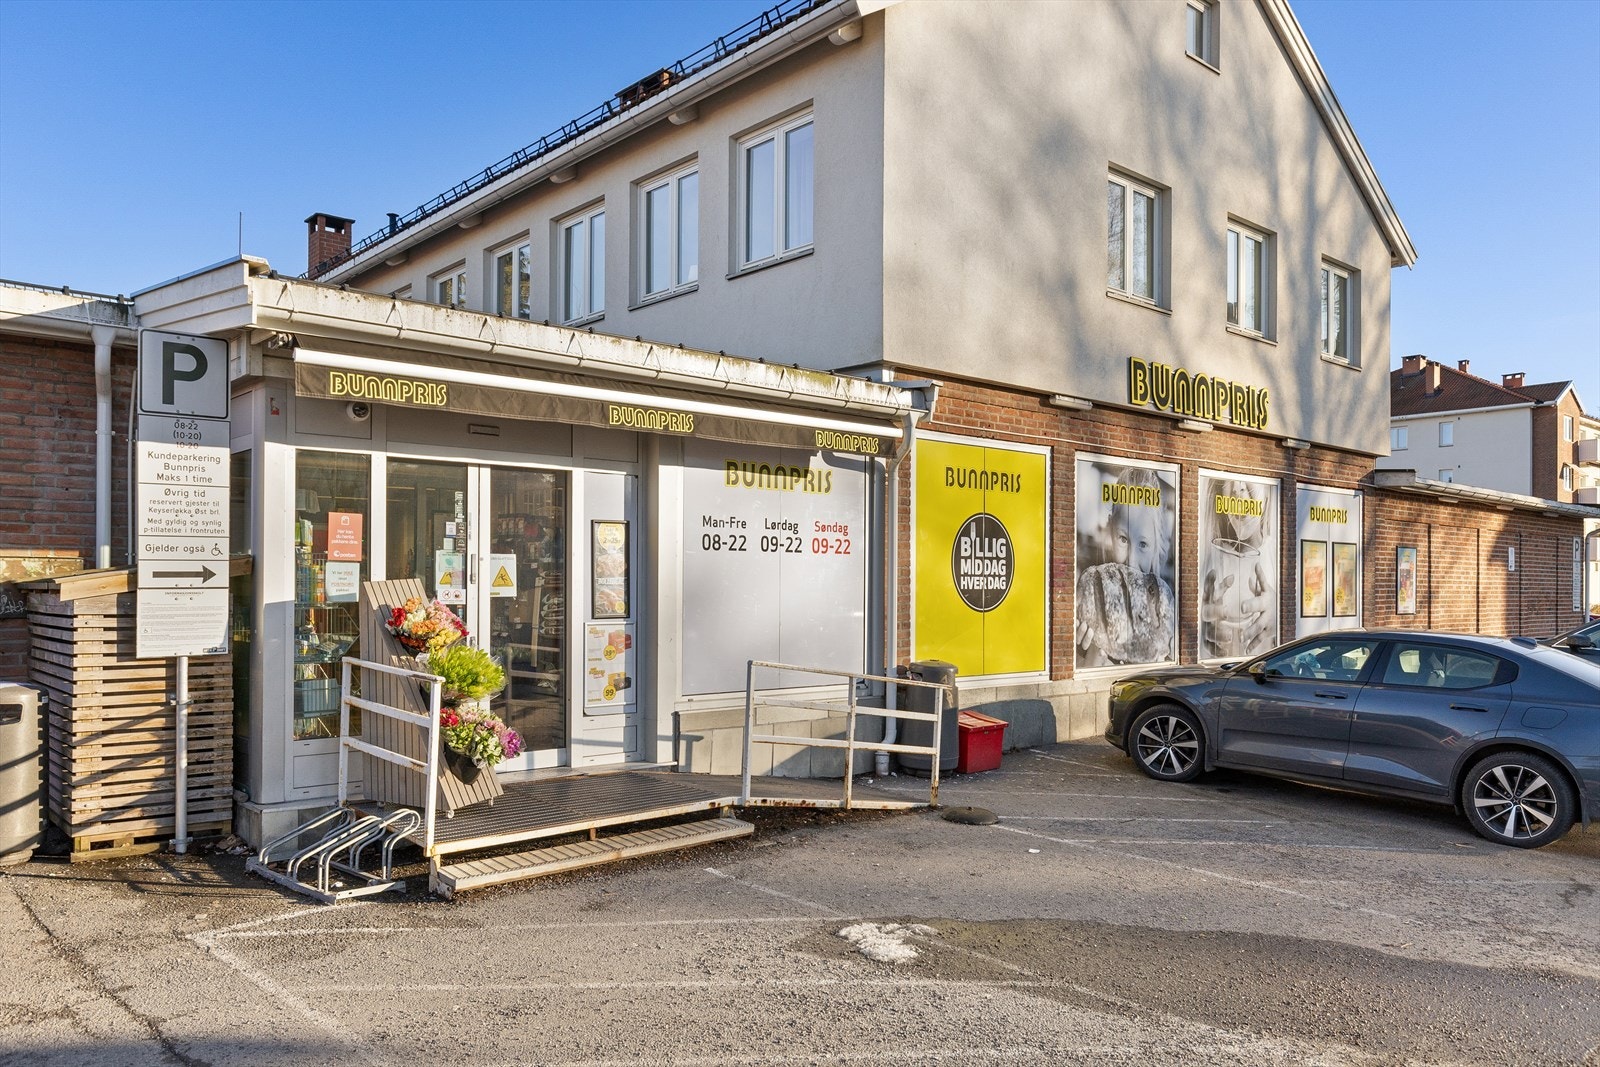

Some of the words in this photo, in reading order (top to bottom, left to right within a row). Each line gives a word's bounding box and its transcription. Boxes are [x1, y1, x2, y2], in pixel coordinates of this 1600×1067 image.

[162, 341, 208, 405] P
[330, 371, 447, 406] BUNNPRIS
[1128, 356, 1270, 431] BUNNPRIS
[174, 421, 198, 431] 08-22
[609, 405, 694, 433] BUNNPRIS
[173, 430, 202, 442] (10-20)
[815, 430, 879, 454] BUNNPRIS
[147, 451, 221, 465] Kundeparkering
[163, 462, 206, 473] Bunnpris
[724, 459, 833, 494] BUNNPRIS
[156, 473, 181, 483] Maks
[192, 475, 213, 484] time
[945, 466, 1022, 493] BUNNPRIS
[164, 488, 189, 499] Øvrig
[193, 489, 206, 498] tid
[1102, 482, 1161, 507] BUNNPRIS
[1215, 494, 1264, 517] BUNNPRIS
[165, 518, 187, 527] gyldig
[201, 519, 222, 528] synlig
[1310, 506, 1348, 524] BUNNPRIS
[144, 527, 182, 535] p-tillatelse
[702, 515, 747, 530] Man-Fre
[764, 517, 799, 534] Lørdag
[814, 520, 849, 536] Søndag
[145, 543, 180, 555] Gjelder
[183, 545, 206, 554] også
[702, 534, 747, 552] 08-22
[760, 535, 802, 554] 09-22
[811, 537, 851, 555] 09-22
[960, 536, 1007, 558] BILLIG
[1574, 540, 1580, 559] P
[960, 558, 1007, 575] MIDDAG
[960, 576, 1007, 590] HVERDAG
[605, 688, 614, 696] 99
